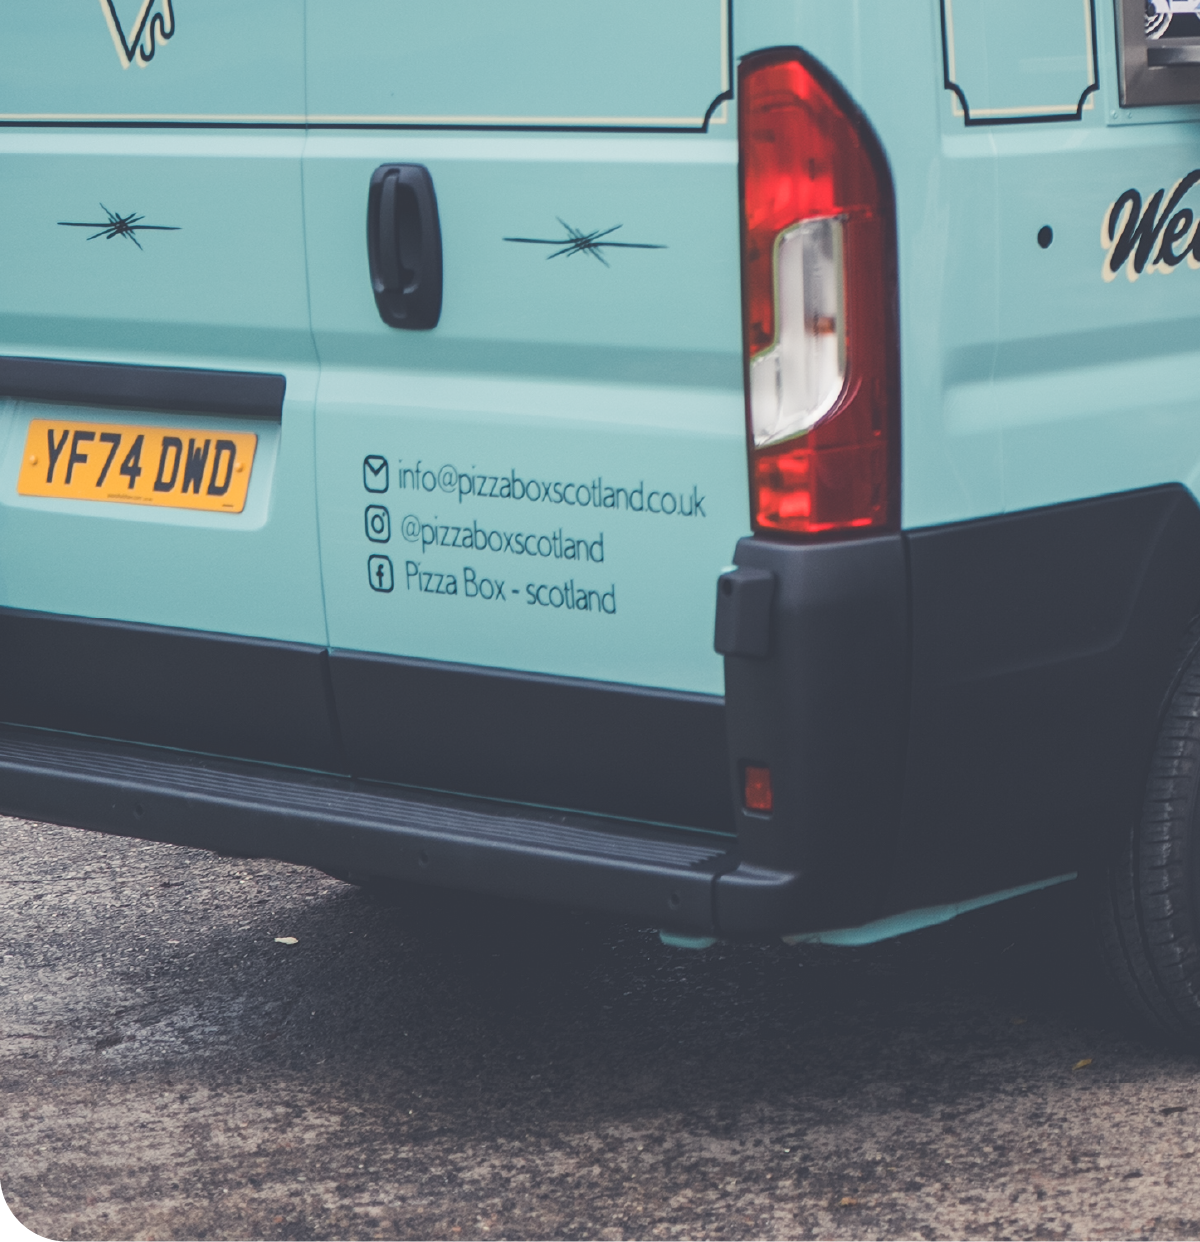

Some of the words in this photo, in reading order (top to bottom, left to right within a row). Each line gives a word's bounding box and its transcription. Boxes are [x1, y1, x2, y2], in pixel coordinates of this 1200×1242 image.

[46, 429, 145, 490] YF74
[153, 436, 237, 497] DWD
[398, 458, 706, 518] info@pizzaboxscotland.co.uk
[401, 514, 605, 563] @pizzaboxscotland
[405, 560, 458, 595] Pizza
[463, 566, 506, 602] Box
[526, 578, 617, 614] scotland
